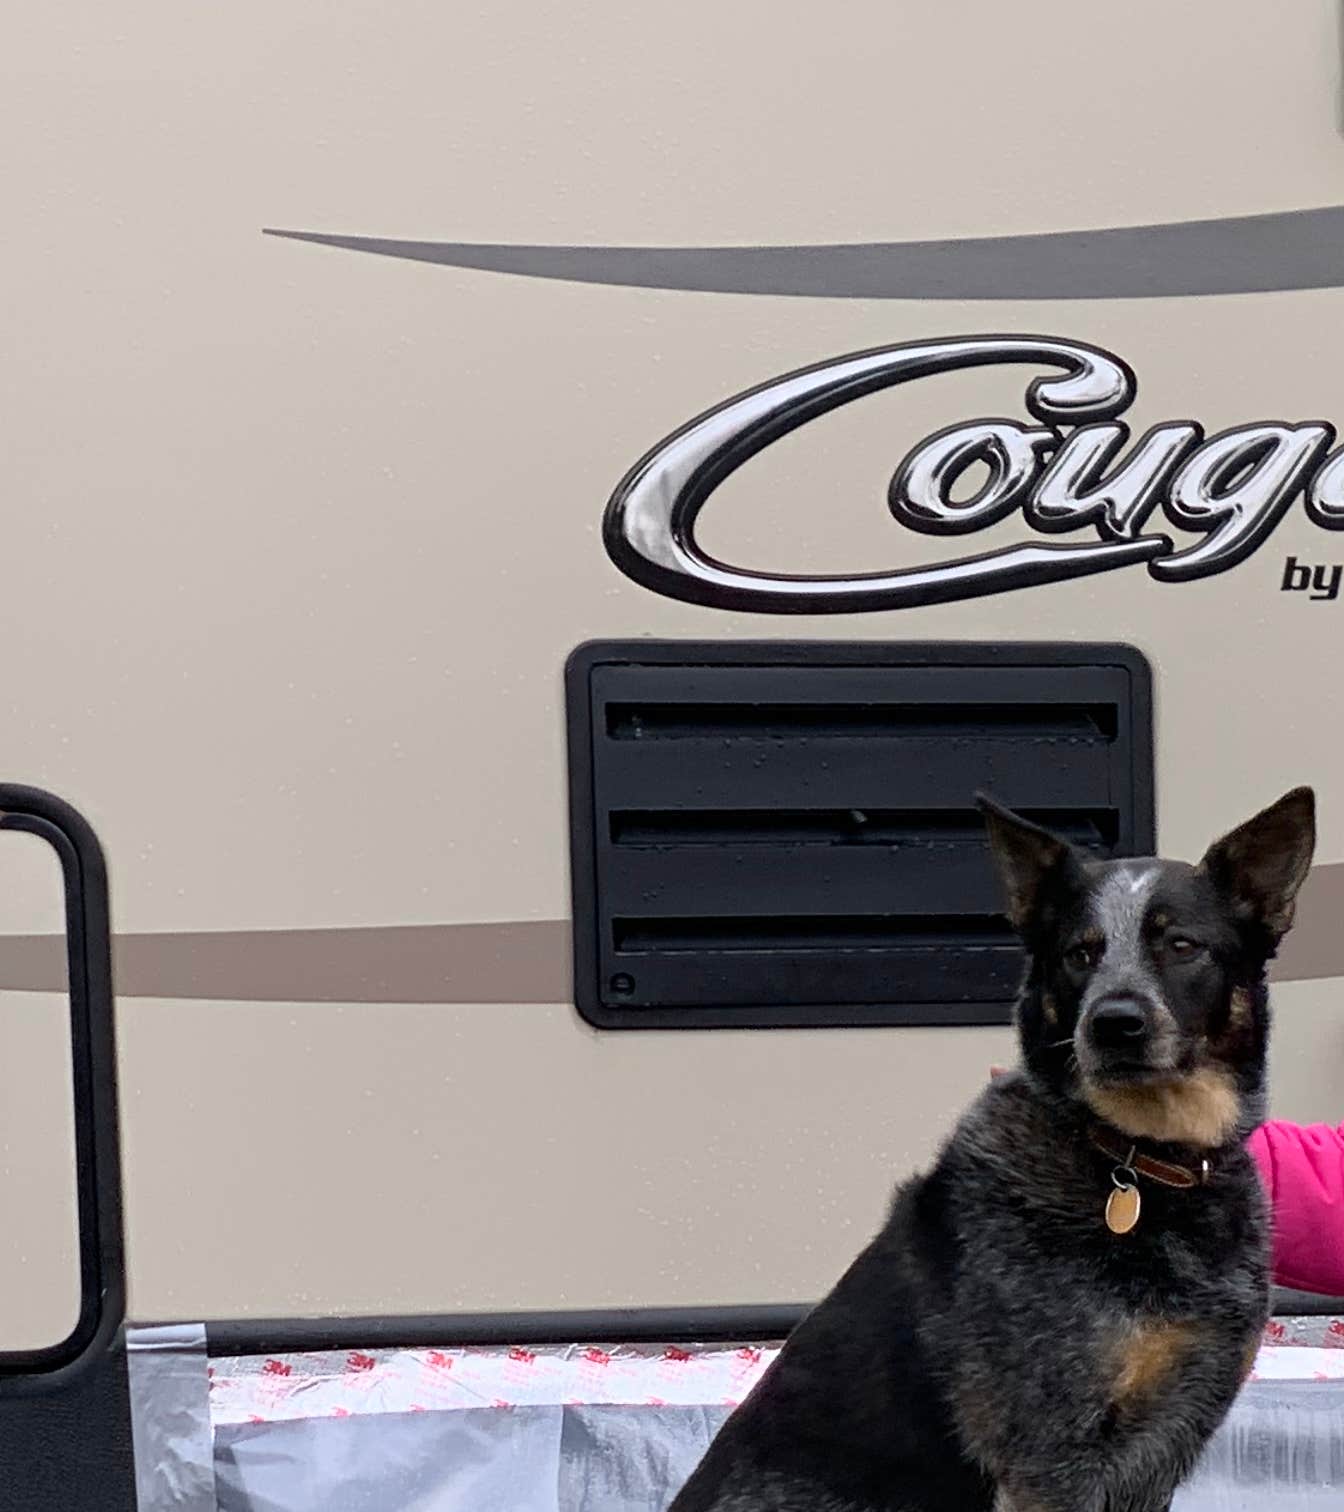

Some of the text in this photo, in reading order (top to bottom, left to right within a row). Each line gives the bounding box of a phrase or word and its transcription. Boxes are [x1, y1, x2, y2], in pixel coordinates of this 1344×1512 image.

[262, 1358, 292, 1377] 3M
[347, 1352, 377, 1371] 3M
[425, 1351, 454, 1369] 3M
